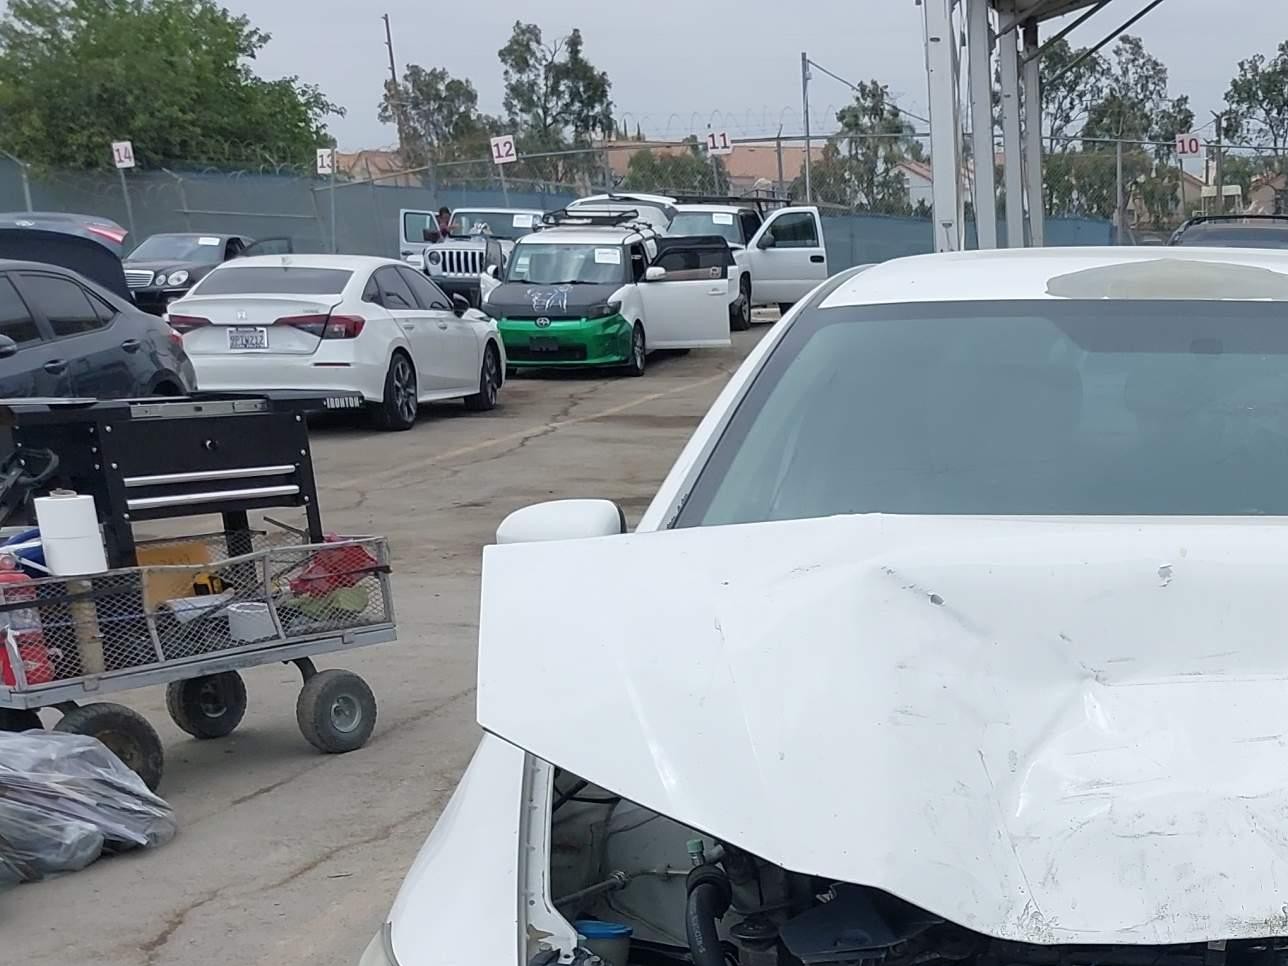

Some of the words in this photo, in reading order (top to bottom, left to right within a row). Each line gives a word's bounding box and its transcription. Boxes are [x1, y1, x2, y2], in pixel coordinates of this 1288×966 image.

[493, 139, 515, 159] 12
[708, 133, 731, 150] 11
[1178, 138, 1200, 155] 10
[114, 146, 133, 164] 14
[326, 396, 360, 409] IRONTON
